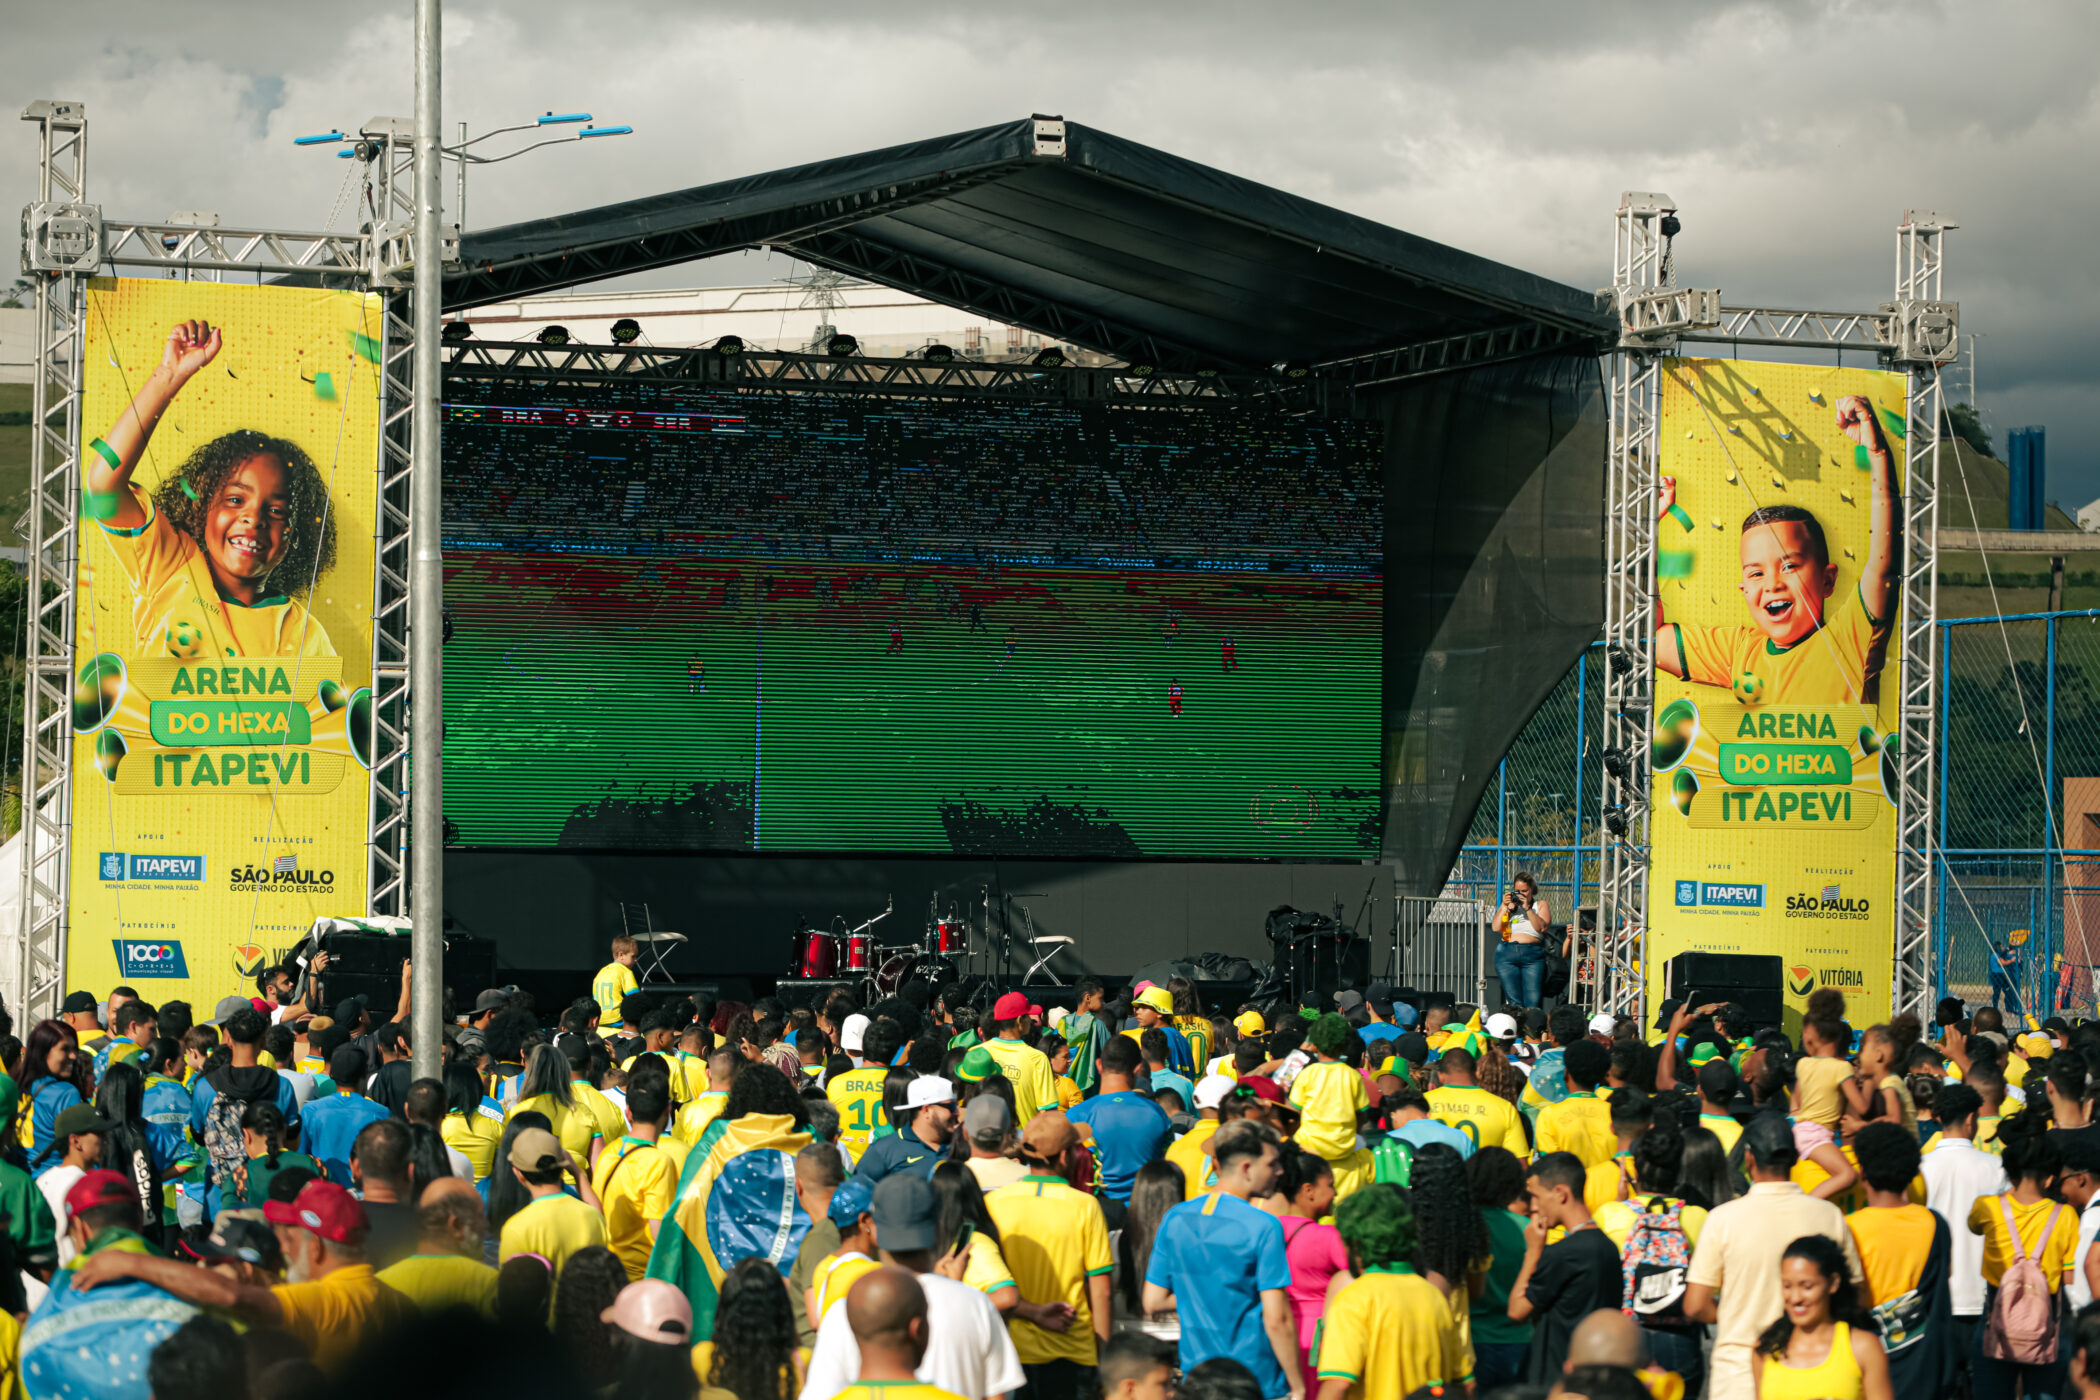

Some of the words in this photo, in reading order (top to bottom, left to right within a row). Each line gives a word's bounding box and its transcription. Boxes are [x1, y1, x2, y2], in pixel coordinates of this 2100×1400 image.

[502, 411, 543, 423] BRA
[171, 666, 292, 695] ARENA
[168, 712, 210, 734] DO
[218, 711, 290, 734] HEXA
[1737, 712, 1837, 739] ARENA
[154, 752, 310, 787] ITAPEVI
[1735, 754, 1770, 774] DO
[1777, 754, 1836, 774] HEXA
[1722, 791, 1851, 821] ITAPEVI
[253, 836, 313, 844] REALIZAÇÃO
[136, 858, 196, 873] ITAPEVI
[230, 864, 270, 884] SÃO
[273, 869, 335, 885] PAULO
[230, 884, 278, 893] GOVERNO
[279, 884, 294, 893] DO
[296, 885, 335, 894] ESTADO
[1707, 886, 1758, 900] ITAPEVI
[1786, 893, 1818, 910] SÃO
[1821, 898, 1870, 912] PAULO
[1786, 911, 1824, 919] GOVERNO
[1839, 913, 1870, 921] ESTADO
[127, 944, 175, 962] 1000
[1820, 966, 1863, 986] VITÓRIA
[1186, 1031, 1206, 1079] 0
[846, 1080, 884, 1093] BRAS
